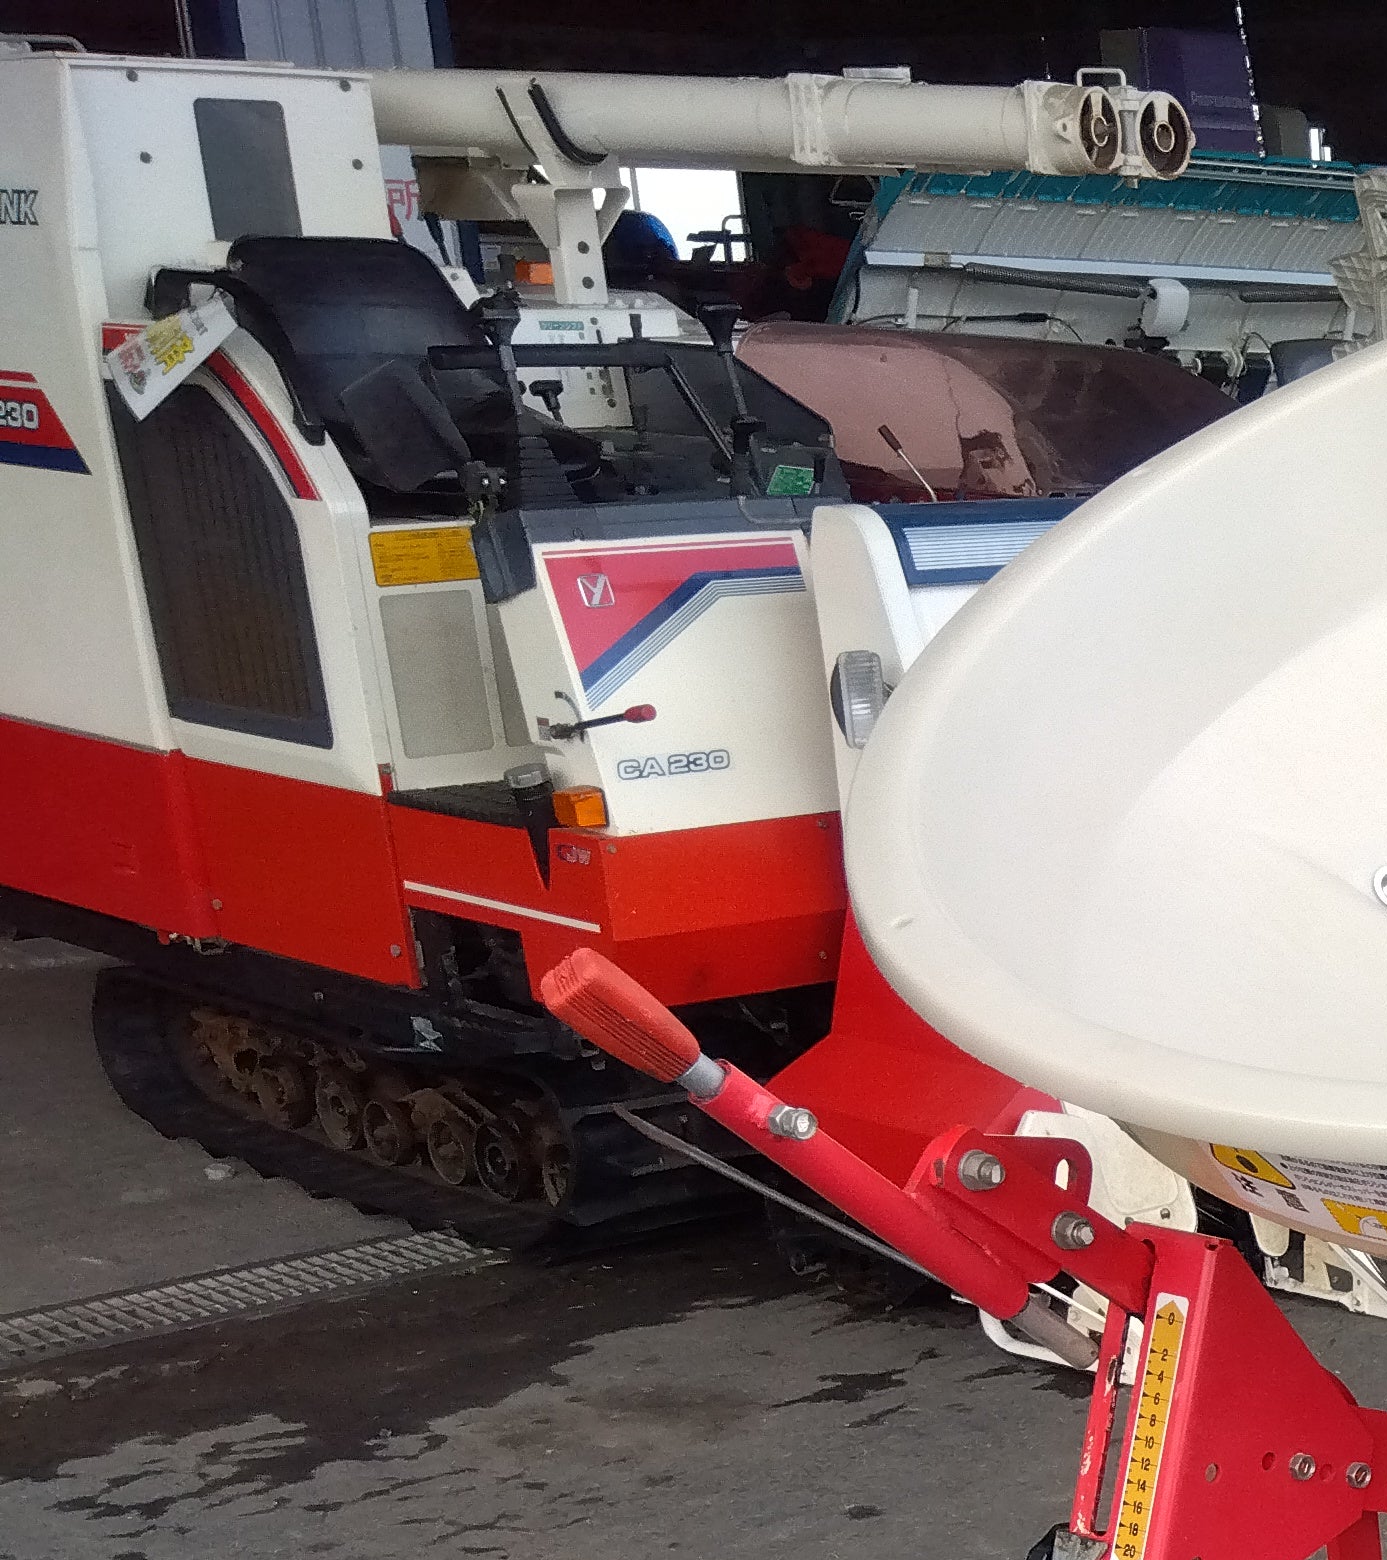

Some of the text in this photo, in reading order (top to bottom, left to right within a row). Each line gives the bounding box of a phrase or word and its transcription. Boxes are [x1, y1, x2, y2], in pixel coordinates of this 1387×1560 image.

[617, 749, 730, 780] CA 230
[1168, 1312, 1175, 1325] 0
[1161, 1348, 1168, 1361] 2
[1157, 1370, 1164, 1383] 4
[1153, 1392, 1161, 1405] 6
[1149, 1414, 1157, 1427] 8
[1145, 1436, 1154, 1449] 10
[1141, 1457, 1151, 1471] 12
[1137, 1479, 1146, 1492] 14
[1133, 1501, 1142, 1514] 16
[1129, 1523, 1138, 1536] 18
[1123, 1544, 1136, 1558] 20
